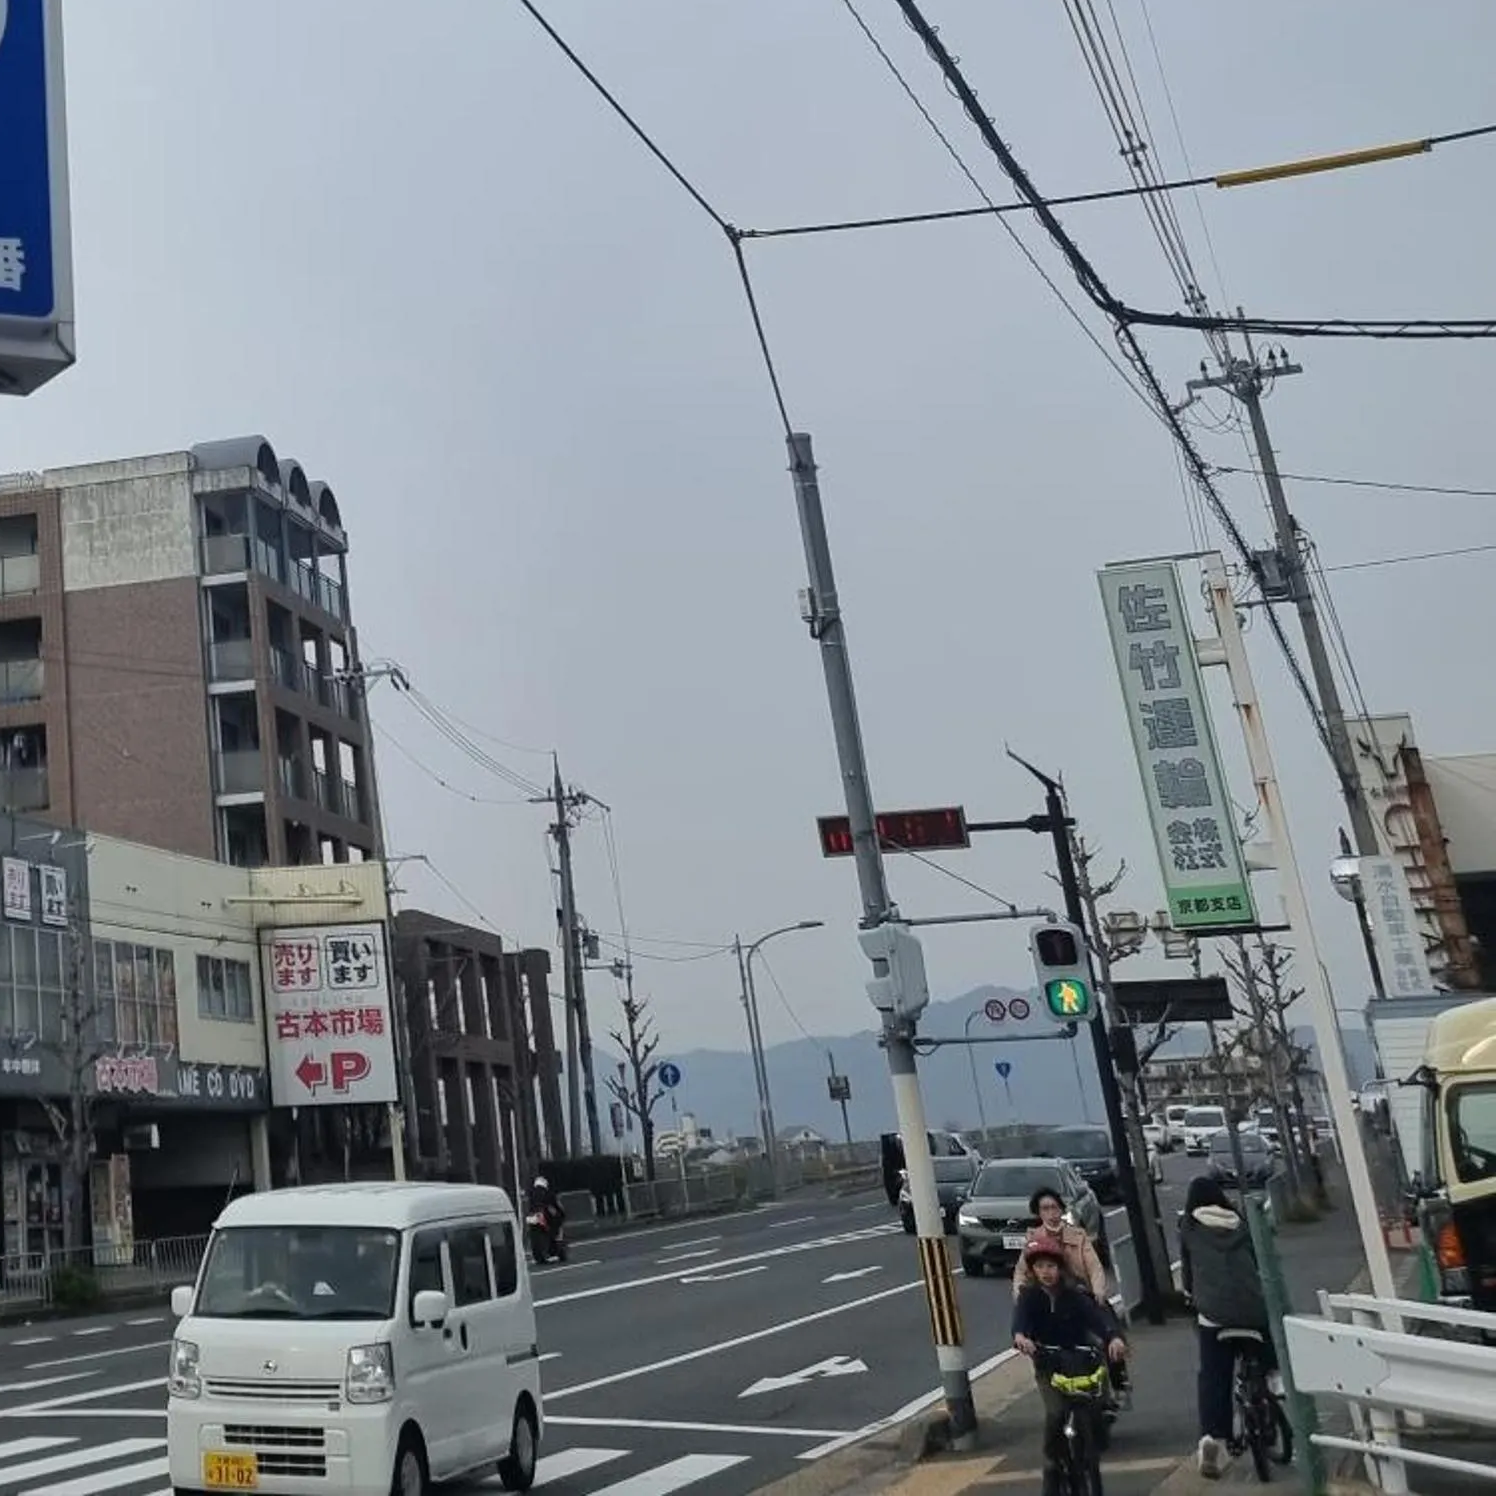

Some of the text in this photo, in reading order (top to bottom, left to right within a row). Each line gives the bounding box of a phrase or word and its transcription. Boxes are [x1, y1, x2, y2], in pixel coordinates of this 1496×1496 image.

[1177, 895, 1242, 914] 京都支店
[275, 1008, 385, 1039] 古本市場
[330, 1052, 371, 1094] P
